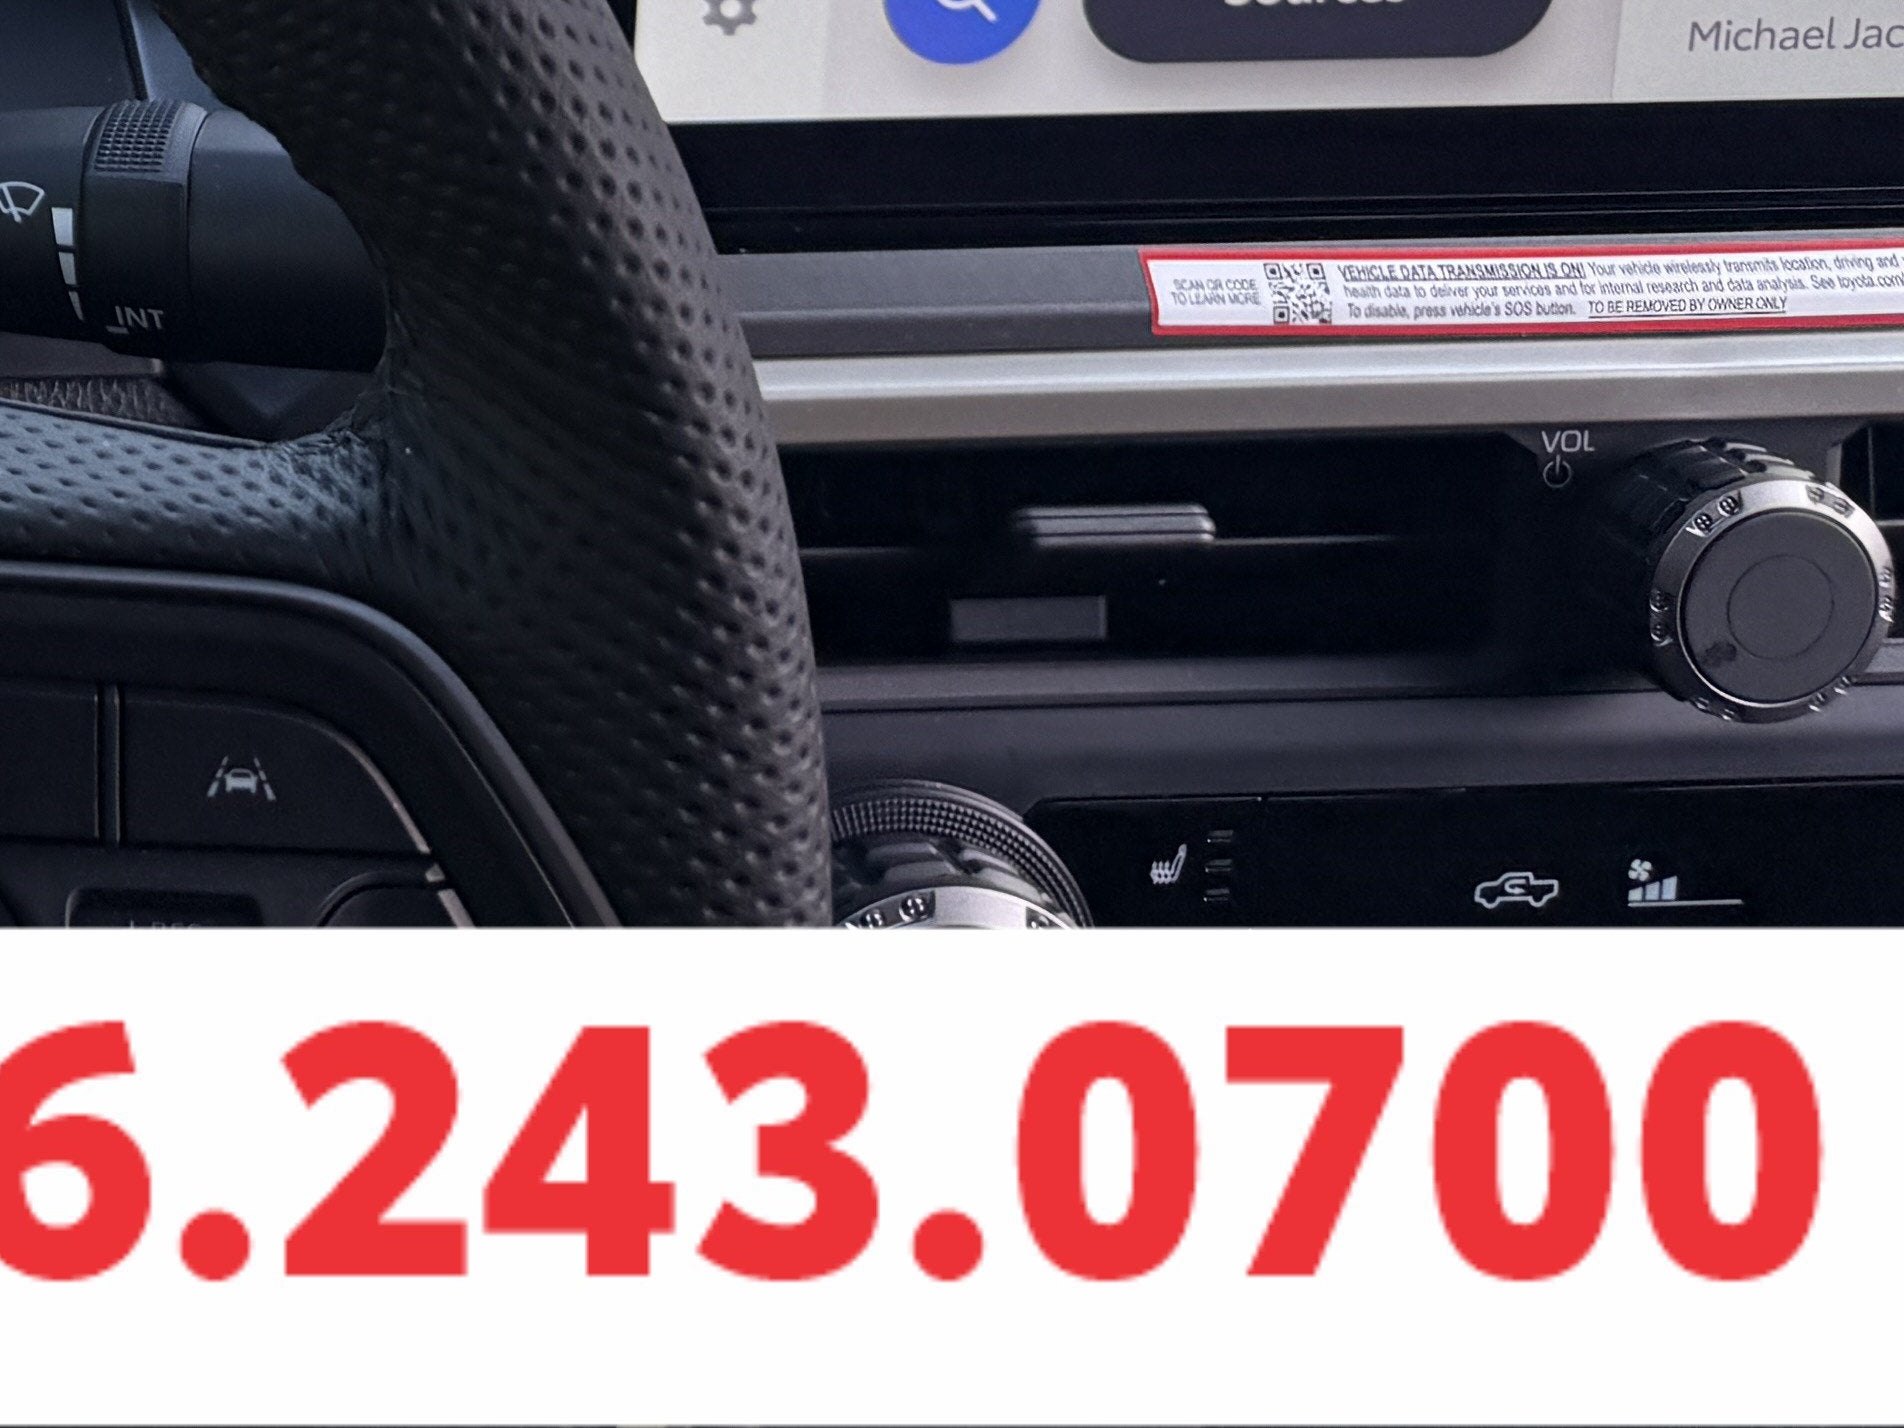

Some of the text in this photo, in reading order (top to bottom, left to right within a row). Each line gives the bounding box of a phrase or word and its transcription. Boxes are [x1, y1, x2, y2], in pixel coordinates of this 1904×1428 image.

[1687, 16, 1836, 53] Michael
[1337, 264, 1398, 282] VEHICLE
[1399, 264, 1438, 281] DATA
[1436, 262, 1542, 281] TRANSMISSION
[1587, 261, 1616, 277] Your
[1618, 260, 1662, 276] vehicle
[1833, 254, 1875, 272] driving
[1876, 253, 1900, 268] and
[1413, 284, 1427, 299] to
[1473, 285, 1498, 301] your
[1554, 282, 1578, 296] and
[1646, 278, 1700, 294] research
[1701, 278, 1724, 293] and
[1726, 277, 1754, 292] data
[1809, 274, 1836, 290] See
[114, 304, 164, 330] INT
[1347, 302, 1362, 318] To
[1504, 301, 1533, 316] SOS
[1588, 300, 1605, 315] TO
[1607, 299, 1624, 313] BE
[1626, 298, 1687, 313] REMOVED
[1689, 297, 1706, 312] BY
[1707, 296, 1754, 311] OWNER
[1755, 295, 1787, 310] ONLY
[1541, 429, 1595, 454] VOL
